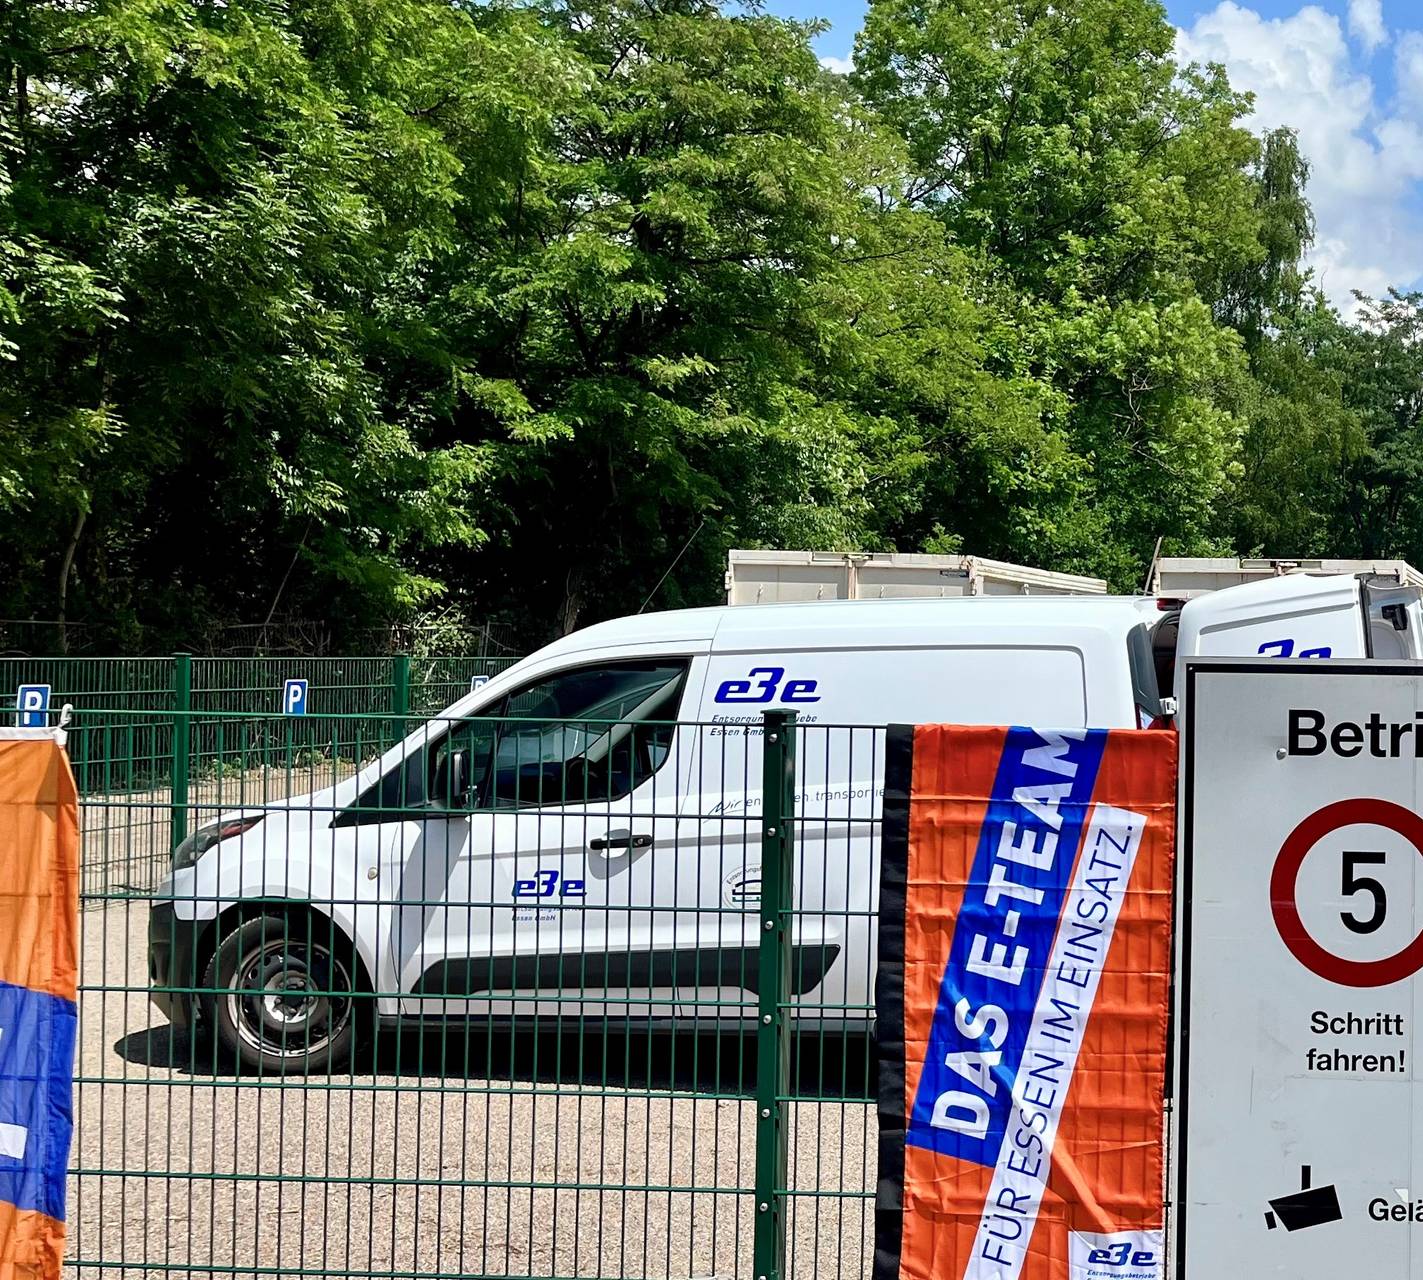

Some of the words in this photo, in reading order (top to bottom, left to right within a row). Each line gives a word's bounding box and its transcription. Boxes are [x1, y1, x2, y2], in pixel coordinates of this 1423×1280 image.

[288, 684, 303, 713] P
[714, 667, 821, 703] e3e
[23, 691, 43, 724] P
[511, 870, 588, 897] e3e
[1339, 850, 1387, 935] 5
[1056, 824, 1134, 989] EINSATZ.
[1040, 998, 1081, 1043] IM
[1310, 1010, 1404, 1036] Schritt
[930, 997, 1009, 1140] DAS
[1305, 1047, 1405, 1073] fahren!
[1007, 1053, 1065, 1178] ESSEN
[982, 1187, 1032, 1266] FÜR
[1088, 1242, 1157, 1266] e3e
